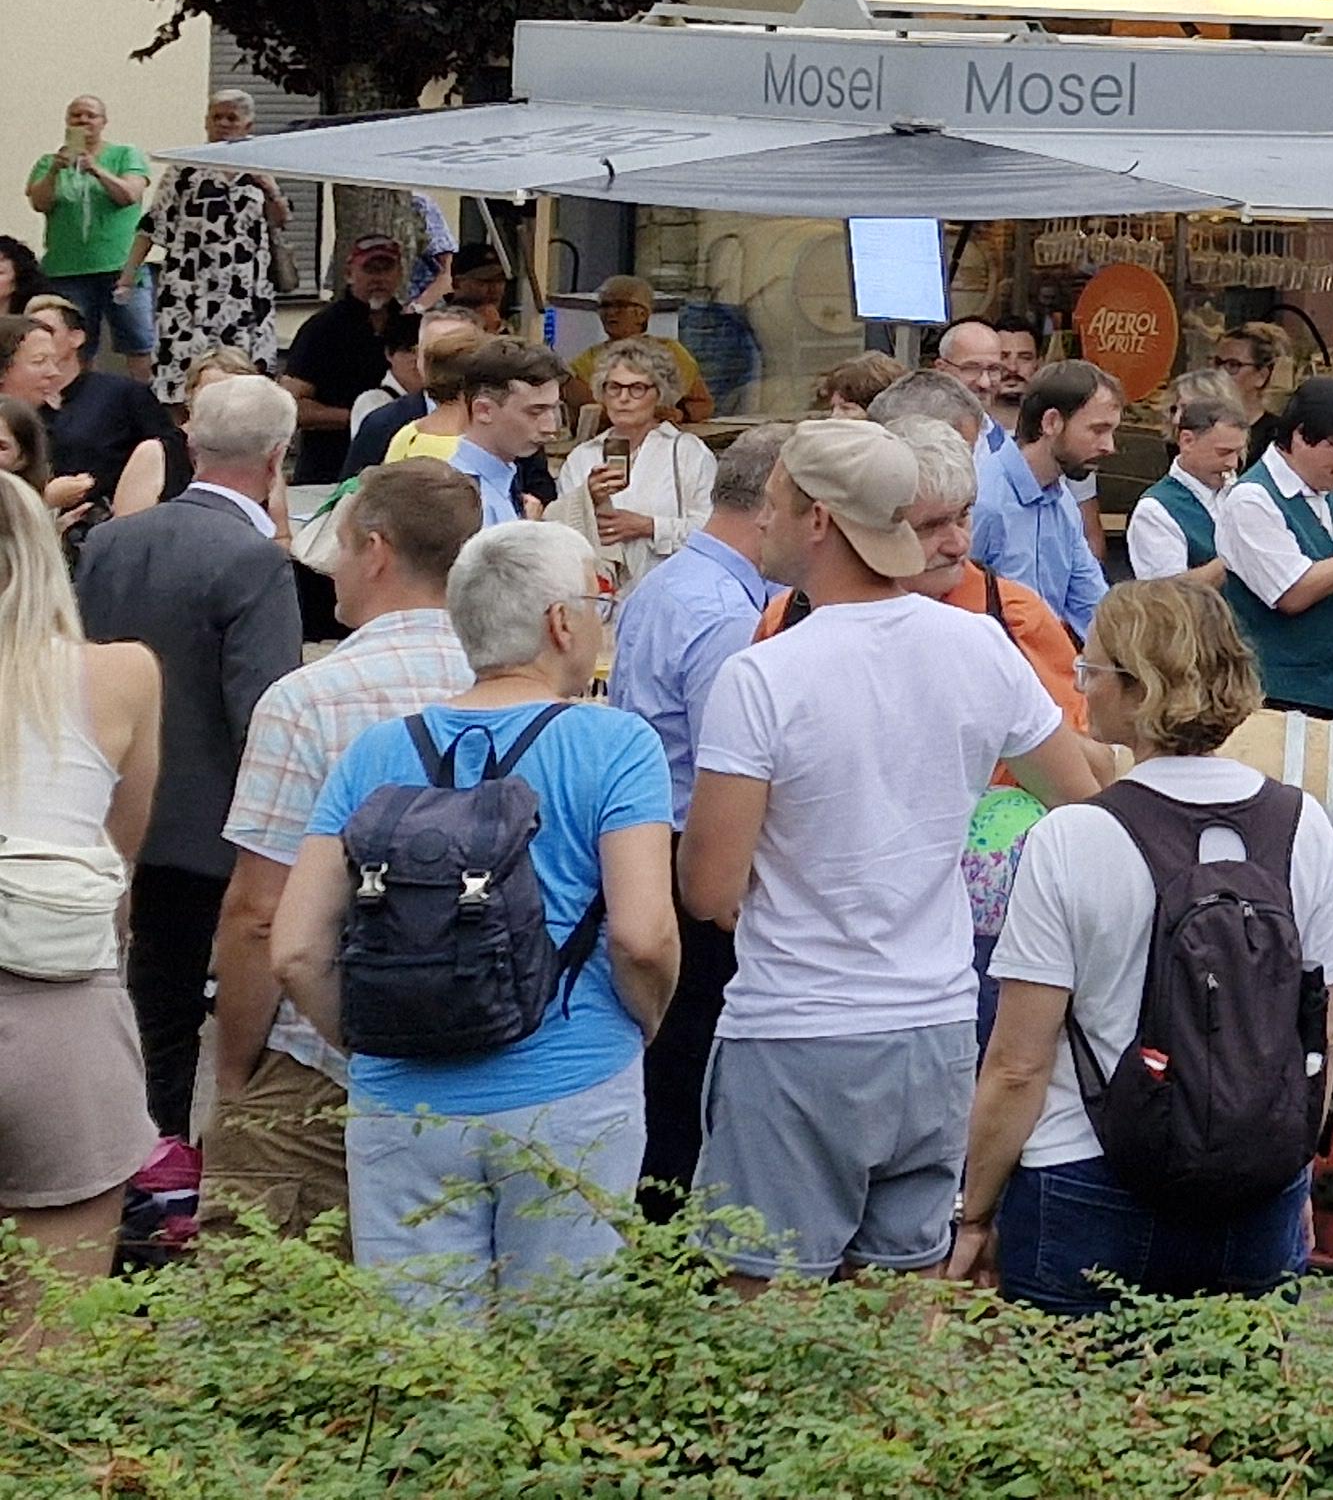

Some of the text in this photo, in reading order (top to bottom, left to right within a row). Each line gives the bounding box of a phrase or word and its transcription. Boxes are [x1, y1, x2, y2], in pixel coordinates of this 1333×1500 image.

[764, 51, 884, 112] Mosel
[964, 60, 1137, 117] Mosel
[1087, 306, 1160, 336] APEROL
[1096, 333, 1147, 354] SPRITZ
